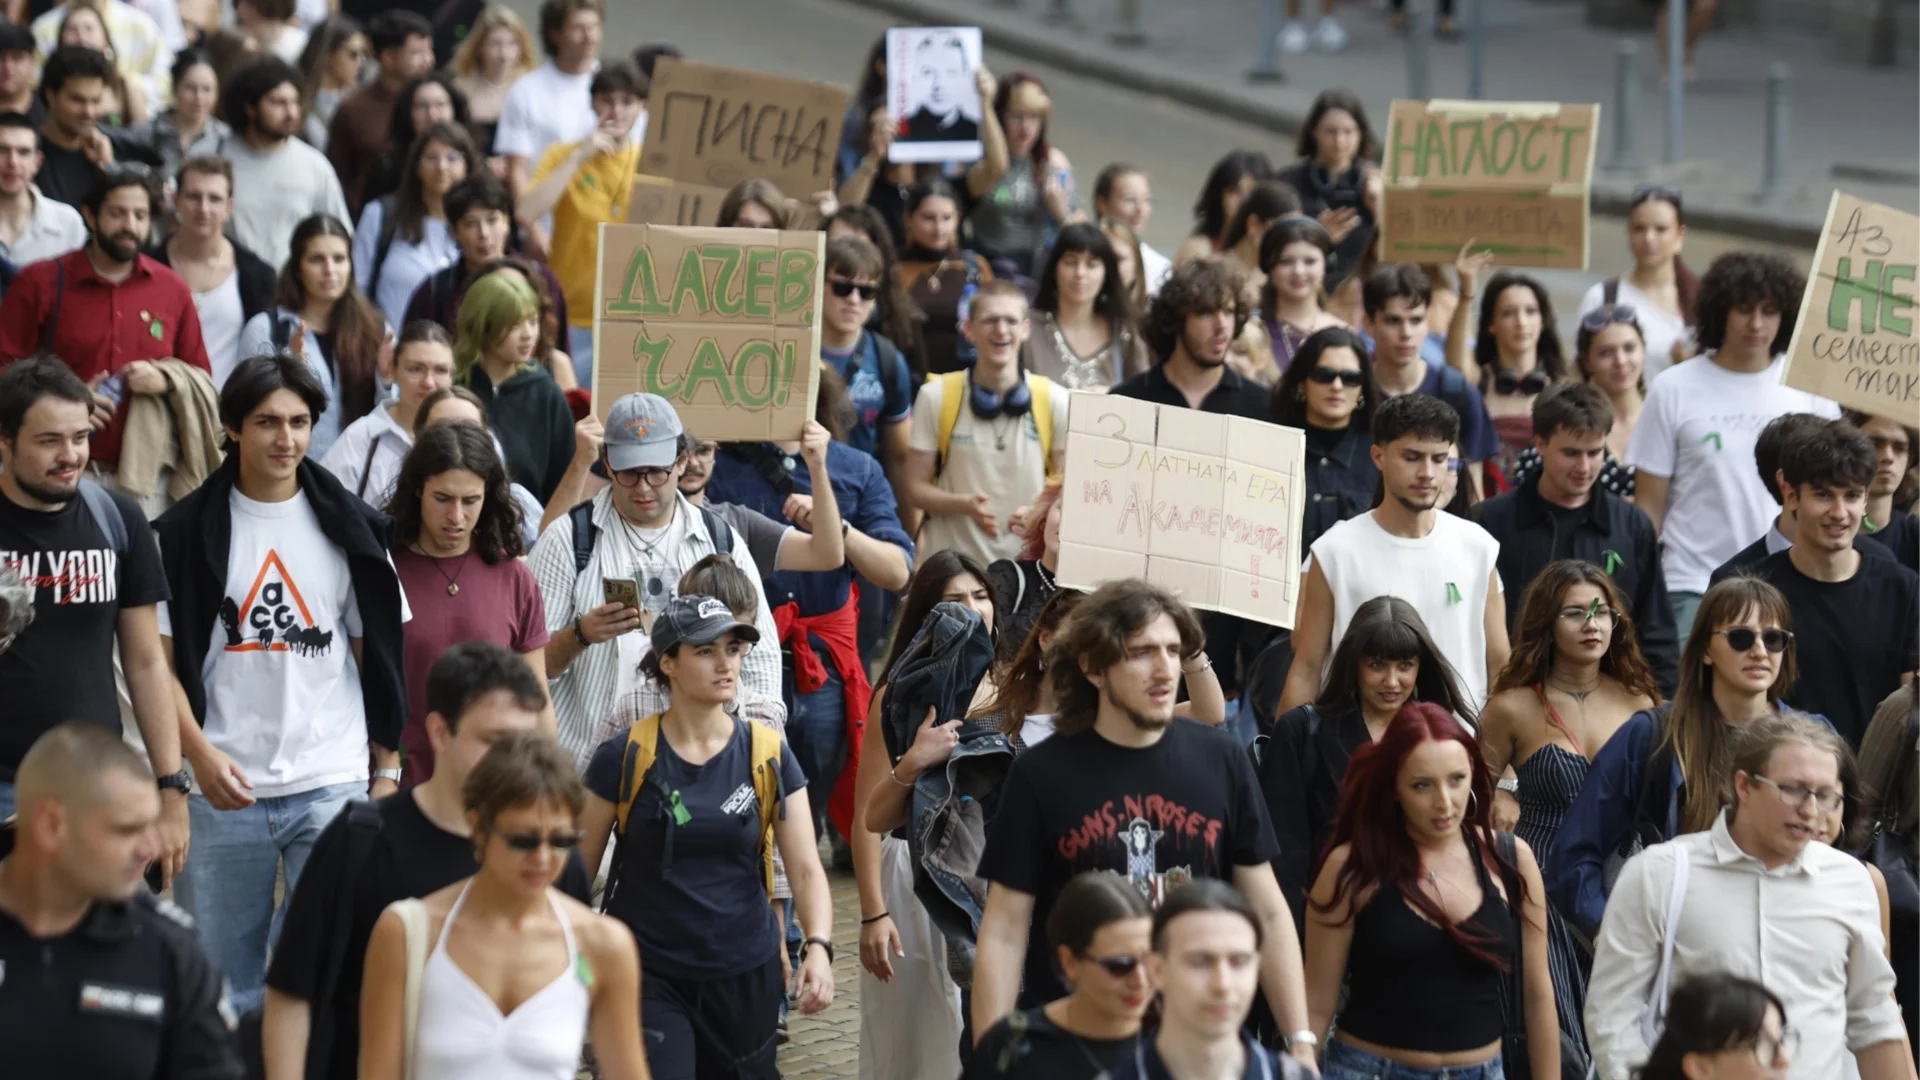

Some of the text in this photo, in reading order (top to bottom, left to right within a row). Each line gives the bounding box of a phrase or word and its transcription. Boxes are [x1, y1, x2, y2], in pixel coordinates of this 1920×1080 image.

[659, 91, 829, 176] ПИСНА
[1392, 118, 1586, 183] НАГЛОСТ
[1827, 257, 1917, 337] НЕ
[633, 333, 797, 412] ЧАО!
[1083, 479, 1113, 504] НА
[1246, 471, 1287, 508] ЕРА
[46, 549, 117, 604] YORK
